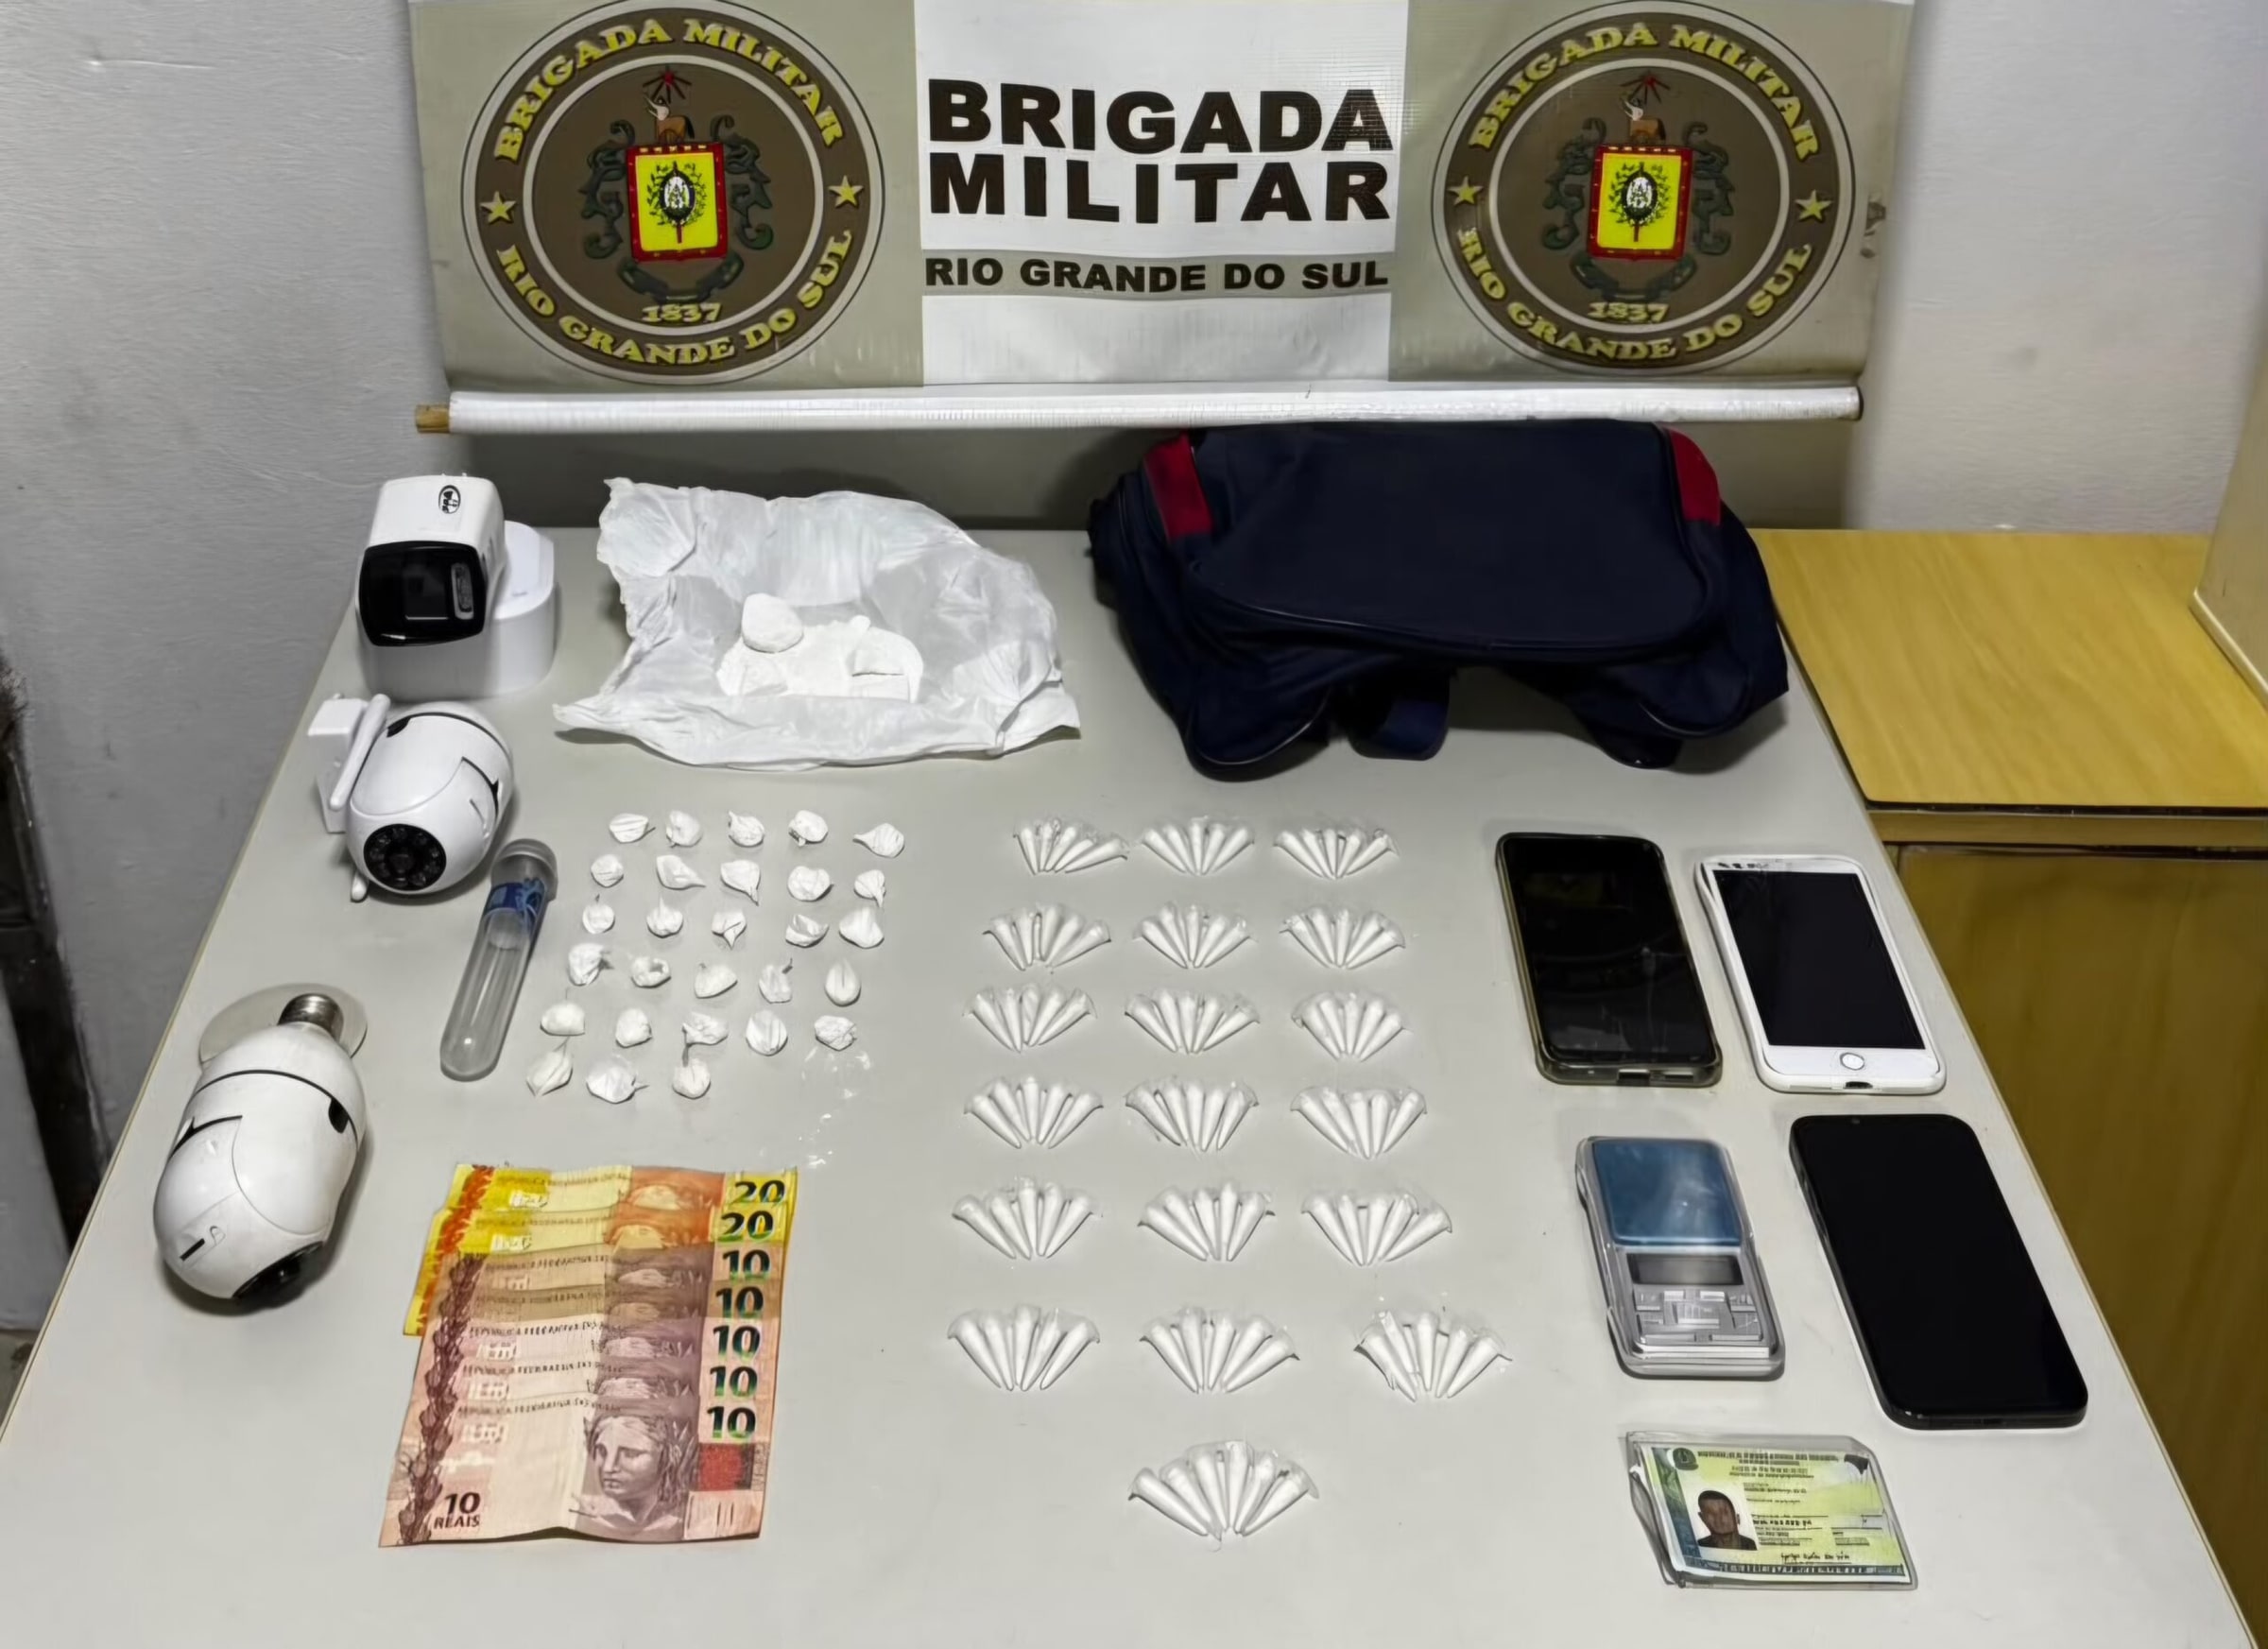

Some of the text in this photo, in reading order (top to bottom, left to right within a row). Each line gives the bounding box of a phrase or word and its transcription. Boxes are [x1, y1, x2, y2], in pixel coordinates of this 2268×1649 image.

[494, 19, 847, 163] BRIGADA MILITAR
[1469, 22, 1821, 161] BRIGADA MILITAR
[929, 78, 1394, 154] BRIGADA
[930, 151, 1391, 224] MILITAR
[925, 257, 1389, 293] RIO GRANDE DO SUL
[495, 229, 852, 365] RIO GRANDE DO SUL
[1457, 227, 1813, 361] RIO GRANDE DO SUL
[642, 301, 722, 323] 1837
[1589, 301, 1669, 323] 1837
[730, 1179, 786, 1203] 20
[717, 1211, 774, 1243] 20
[722, 1249, 770, 1281] 10
[715, 1286, 764, 1318] 10
[713, 1325, 761, 1361] 10
[710, 1366, 758, 1397] 10
[707, 1405, 756, 1439] 10
[444, 1491, 481, 1515] 10
[434, 1515, 480, 1529] REAIS
